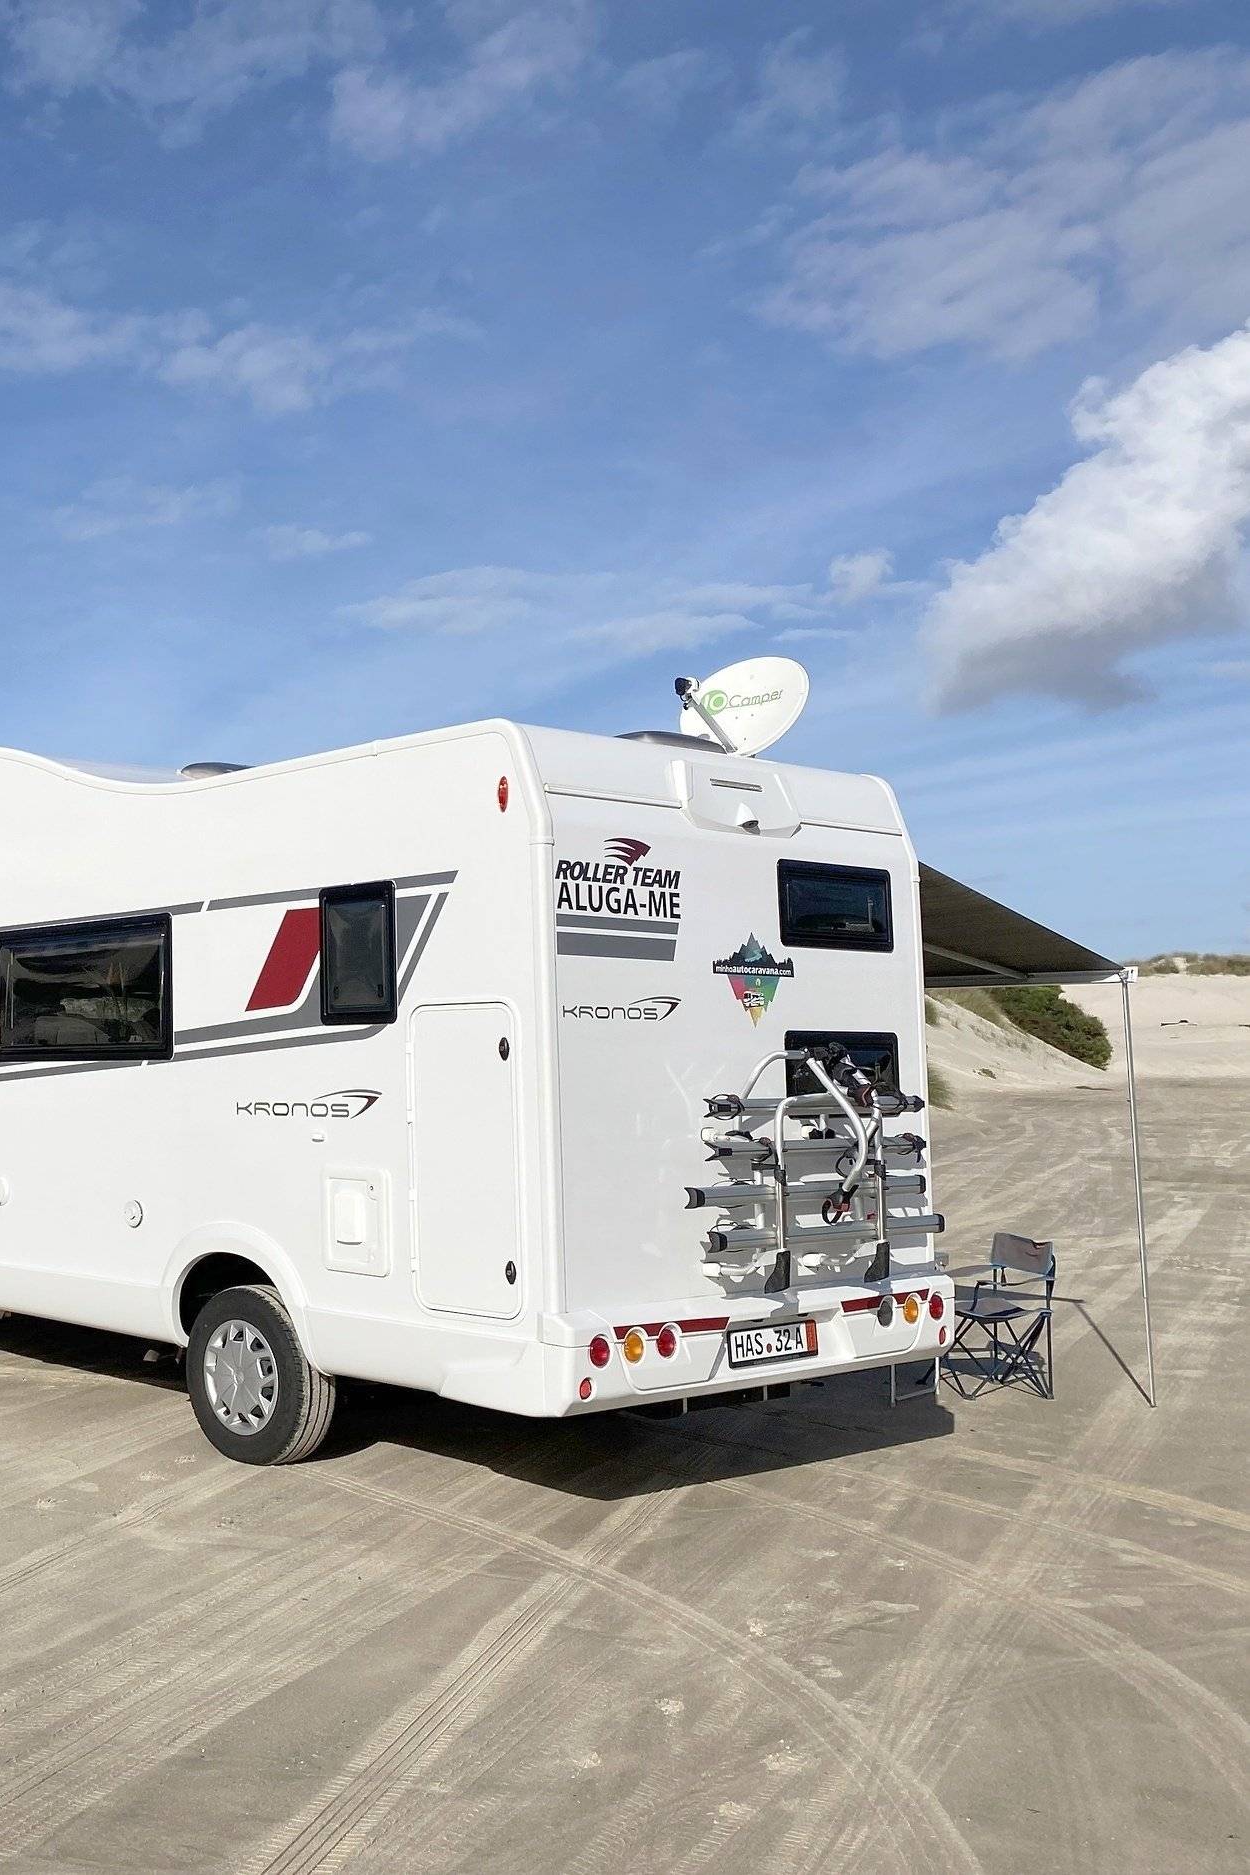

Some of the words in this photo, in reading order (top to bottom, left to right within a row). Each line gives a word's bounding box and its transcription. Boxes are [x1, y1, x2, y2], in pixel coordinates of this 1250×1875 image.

[555, 859, 628, 885] ROLLER
[632, 866, 681, 889] TEAM
[556, 881, 681, 919] ALUGA-ME
